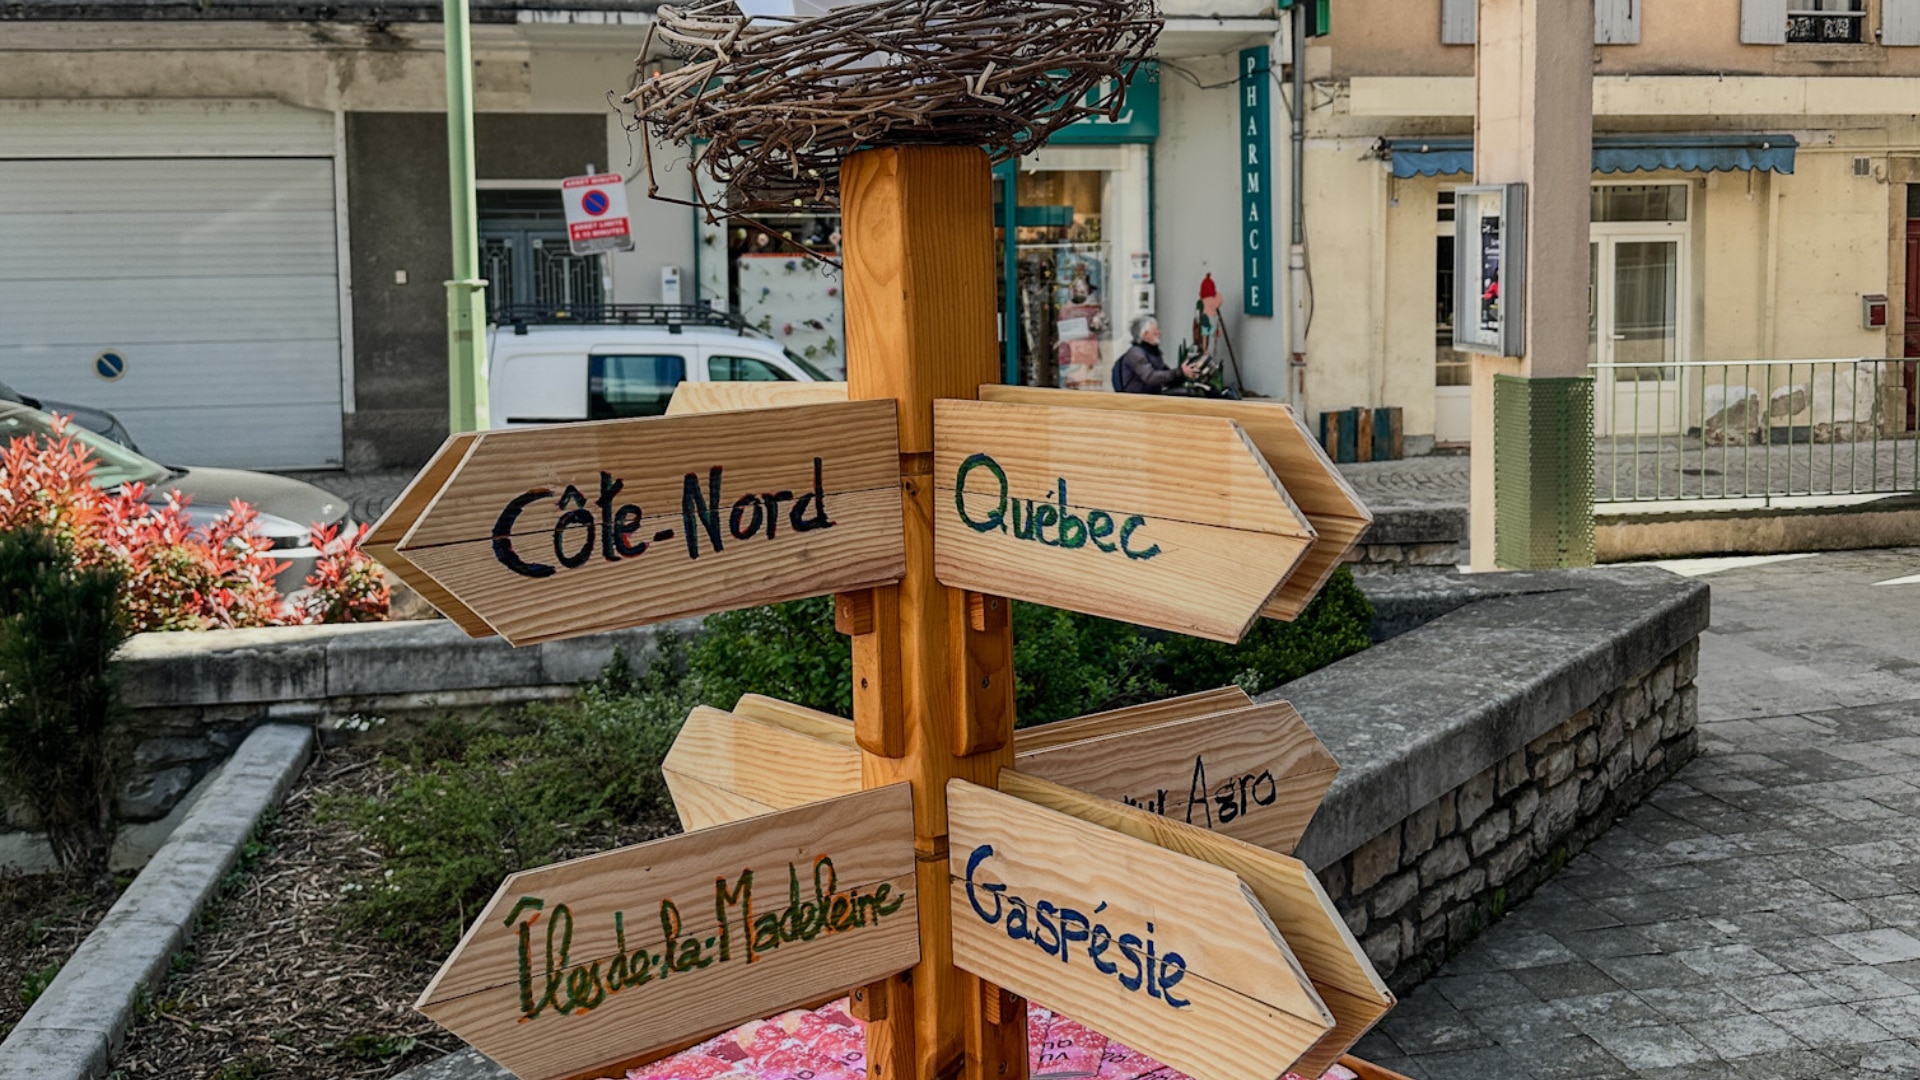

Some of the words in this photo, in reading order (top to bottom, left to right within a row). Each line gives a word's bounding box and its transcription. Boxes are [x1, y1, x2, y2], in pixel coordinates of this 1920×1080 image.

[1246, 56, 1260, 307] PHARMACIE
[492, 456, 838, 579] Côte-Nord
[955, 452, 1163, 560] Québec
[1185, 753, 1277, 829] Agro
[965, 844, 1192, 1009] Gaspésie
